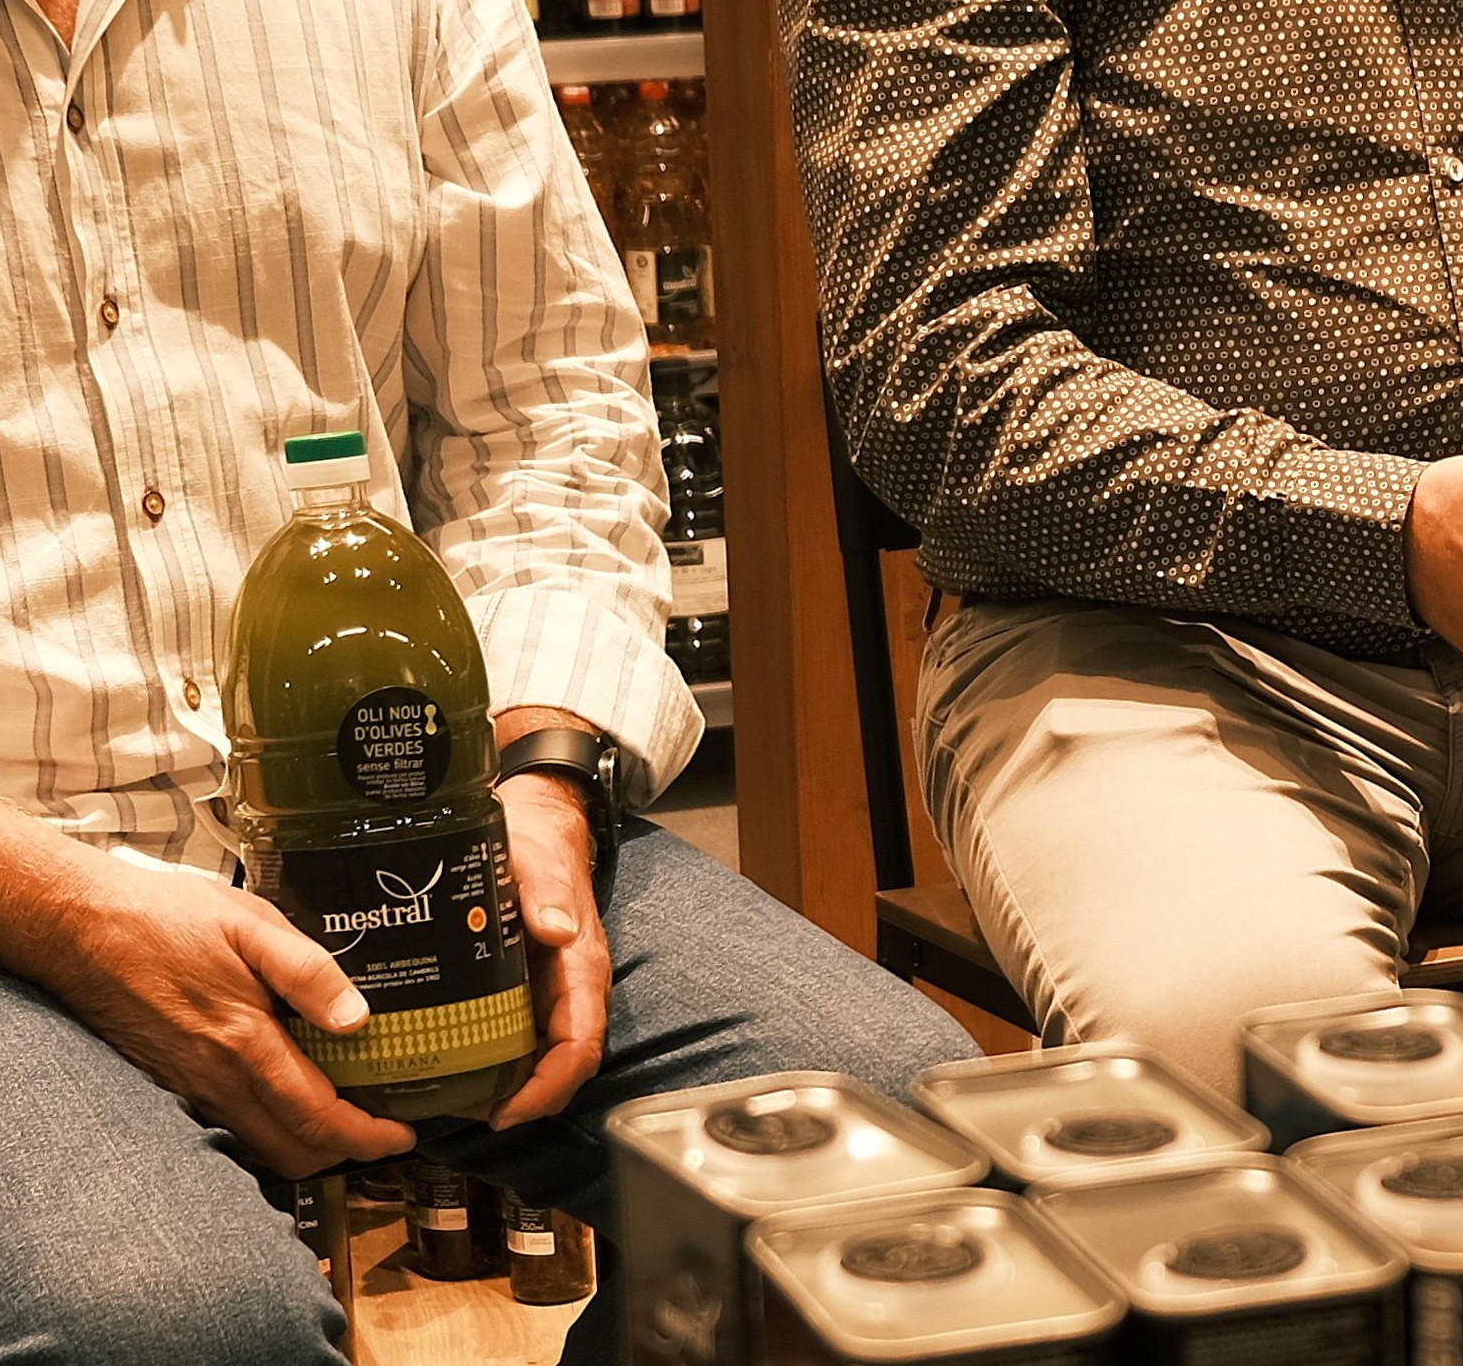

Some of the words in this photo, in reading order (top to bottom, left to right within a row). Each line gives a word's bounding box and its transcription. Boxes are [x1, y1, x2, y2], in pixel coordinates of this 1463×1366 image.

[357, 707, 384, 723] OLI
[389, 705, 421, 721] NOU
[354, 722, 423, 741] D'OLIVES
[363, 740, 424, 758] VERDES
[357, 761, 391, 773] sense
[322, 893, 434, 934] mestral
[473, 940, 493, 961] 2L
[366, 962, 388, 973] 100%
[366, 1054, 442, 1073] SIURANA
[520, 1221, 545, 1231] 250ml
